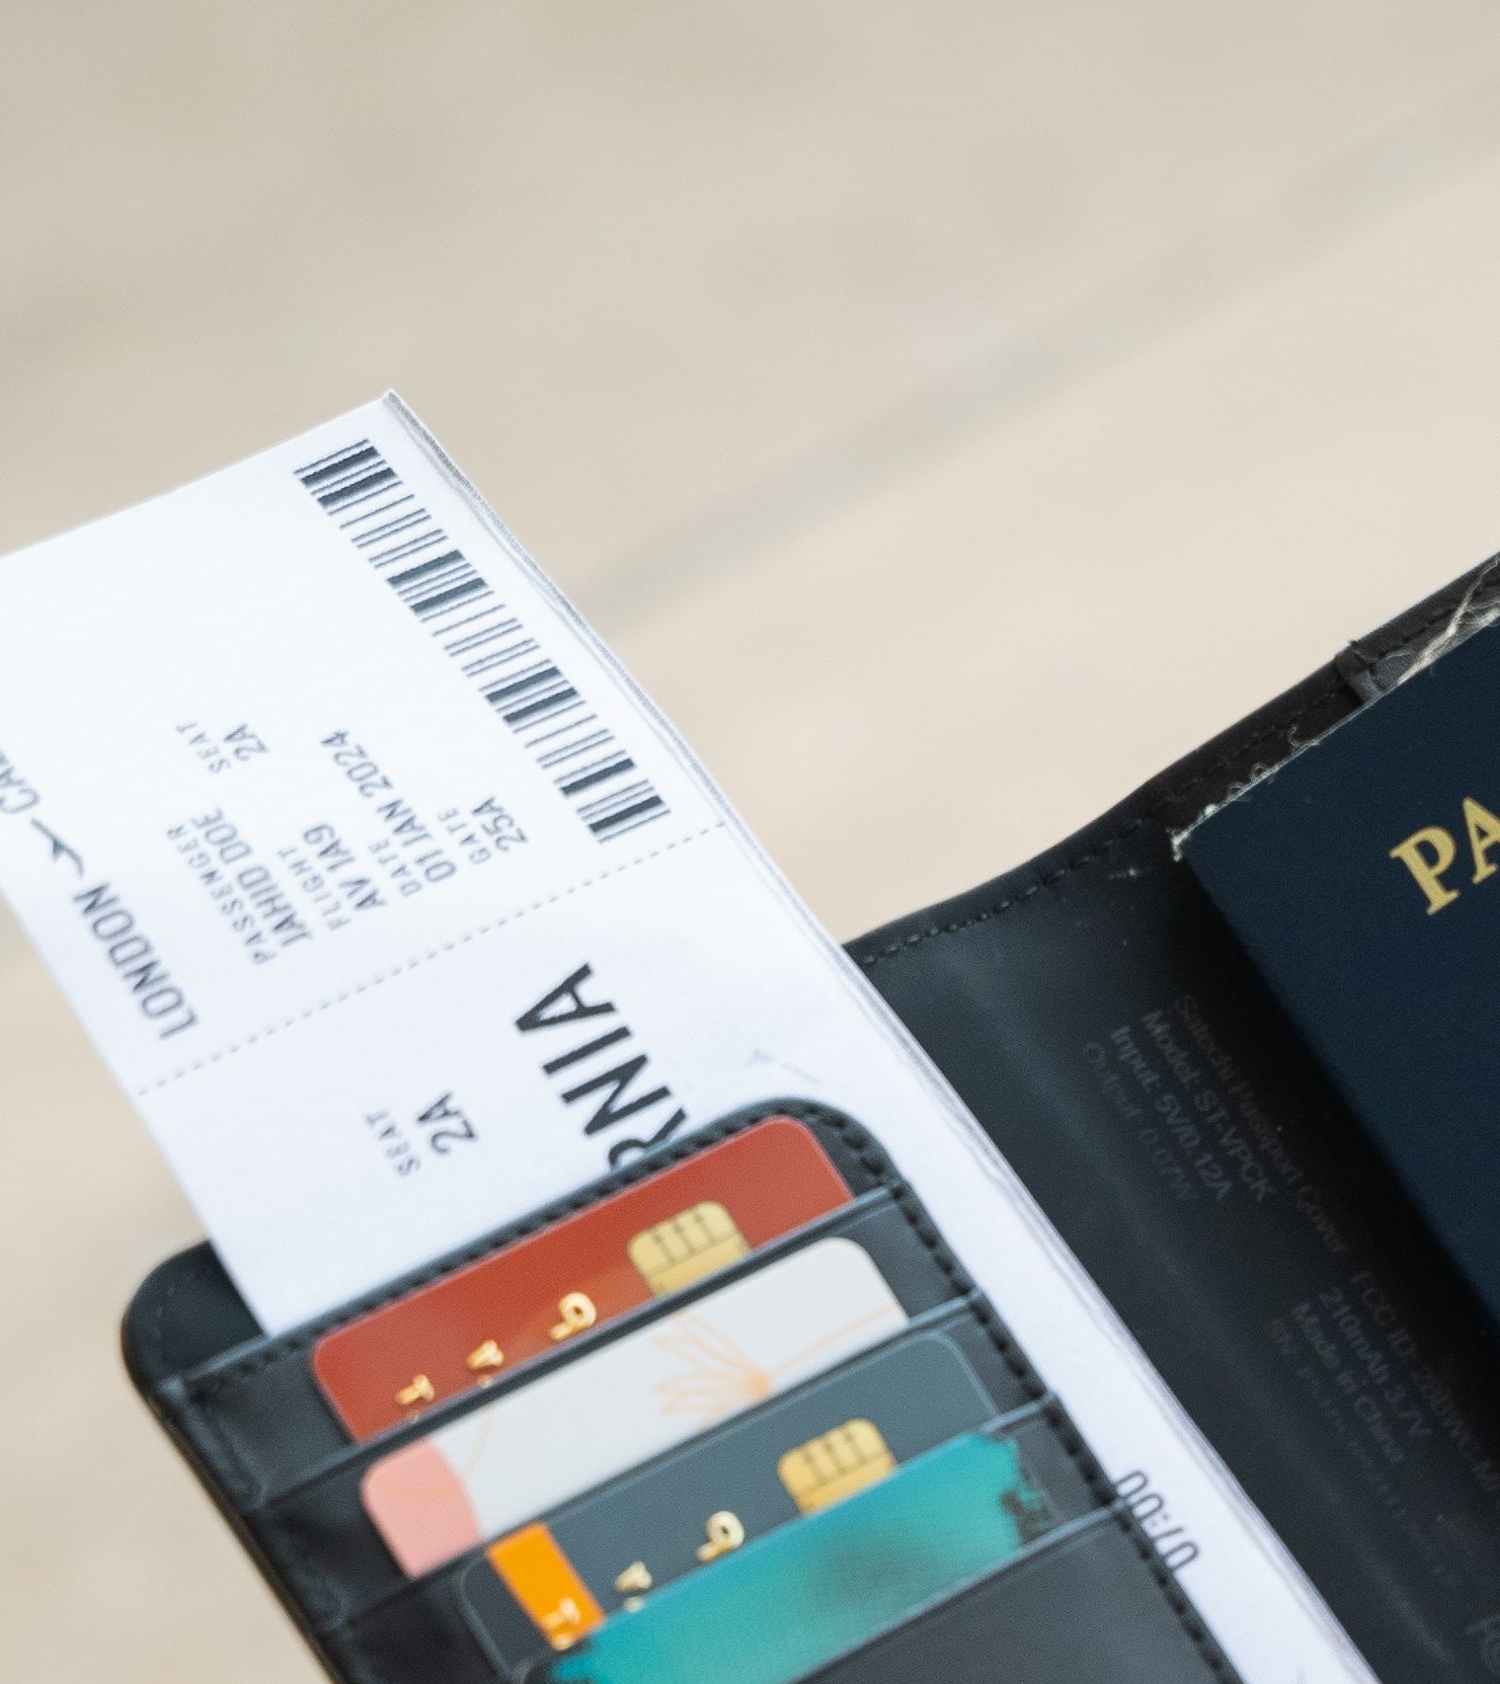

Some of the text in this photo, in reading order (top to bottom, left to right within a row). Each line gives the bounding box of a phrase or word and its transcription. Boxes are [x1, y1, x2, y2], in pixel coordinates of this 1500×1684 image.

[174, 719, 232, 775] SEAT
[221, 722, 268, 763] 2A
[319, 727, 458, 885] 01 JAN 2024
[436, 806, 493, 866] GATE
[470, 795, 529, 854] 25A
[165, 823, 276, 966] PASSENGER
[190, 807, 313, 951] JAHID DOE
[276, 844, 351, 932] FLIGHT
[301, 821, 387, 914] AV 1A9
[368, 837, 424, 897] DATE
[71, 880, 199, 1041] LONDON
[363, 1108, 423, 1180] SEAT
[414, 1092, 479, 1158] 2A
[1141, 1008, 1276, 1203] Model: ST-VPCK
[1172, 993, 1349, 1257] Satechi Passport Cover
[1348, 1269, 1394, 1325] FCC
[1290, 1300, 1406, 1466] Made in China
[1318, 1285, 1432, 1440] 210mAh 3.7V
